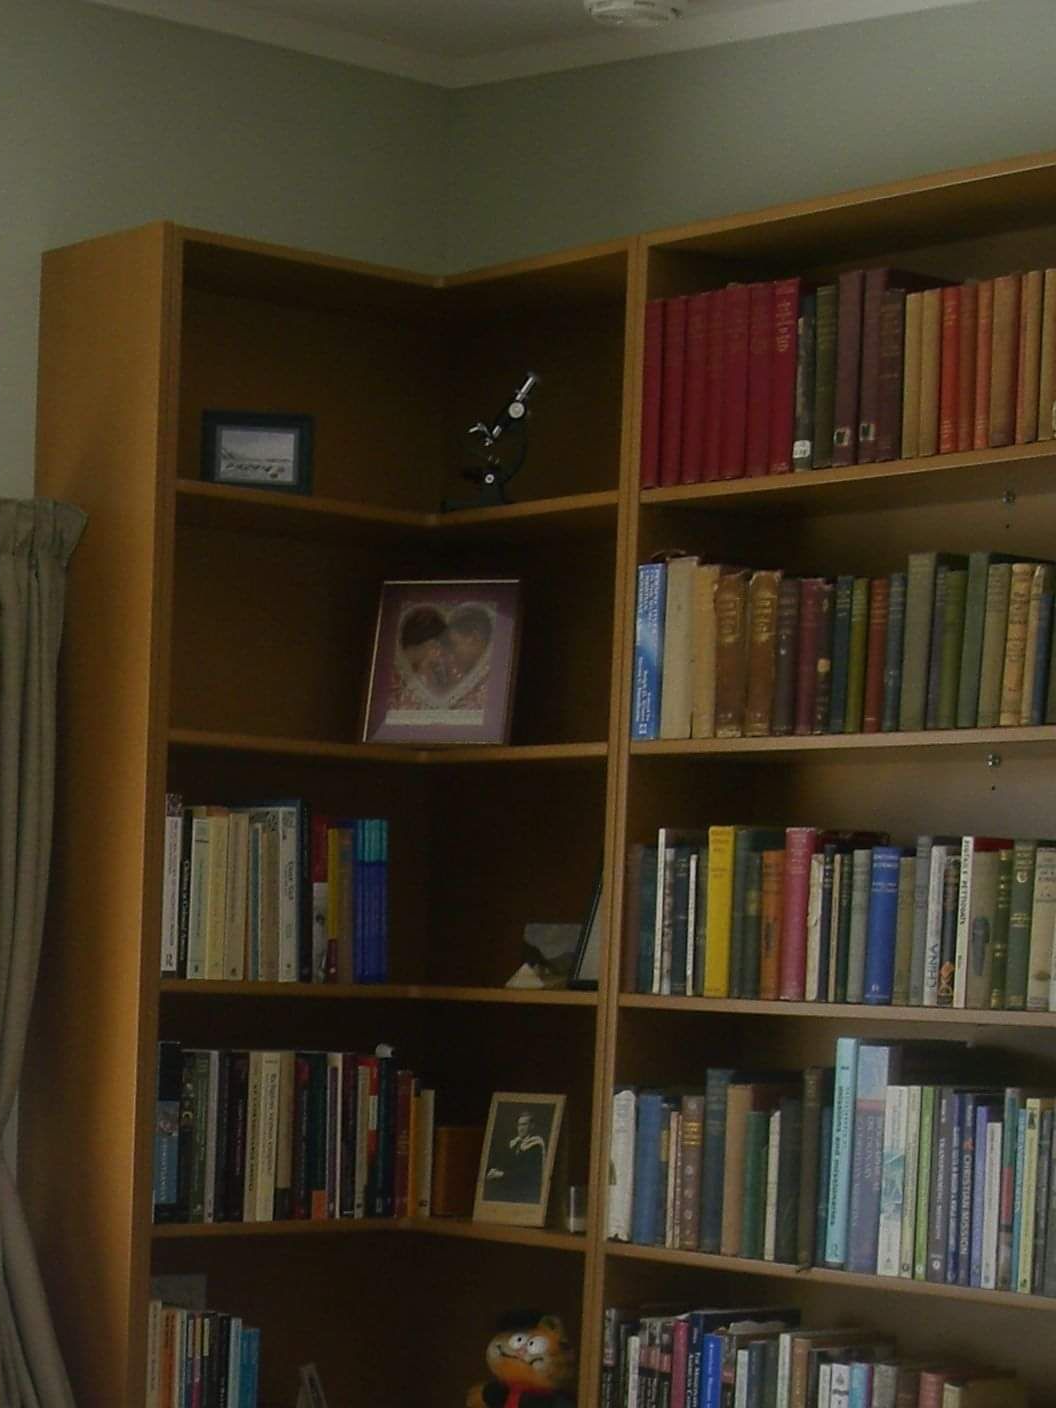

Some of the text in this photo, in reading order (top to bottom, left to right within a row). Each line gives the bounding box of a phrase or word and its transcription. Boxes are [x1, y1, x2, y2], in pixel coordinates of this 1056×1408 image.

[927, 944, 938, 988] CHINA
[960, 1154, 972, 1255] CHRISTIAN MISSION
